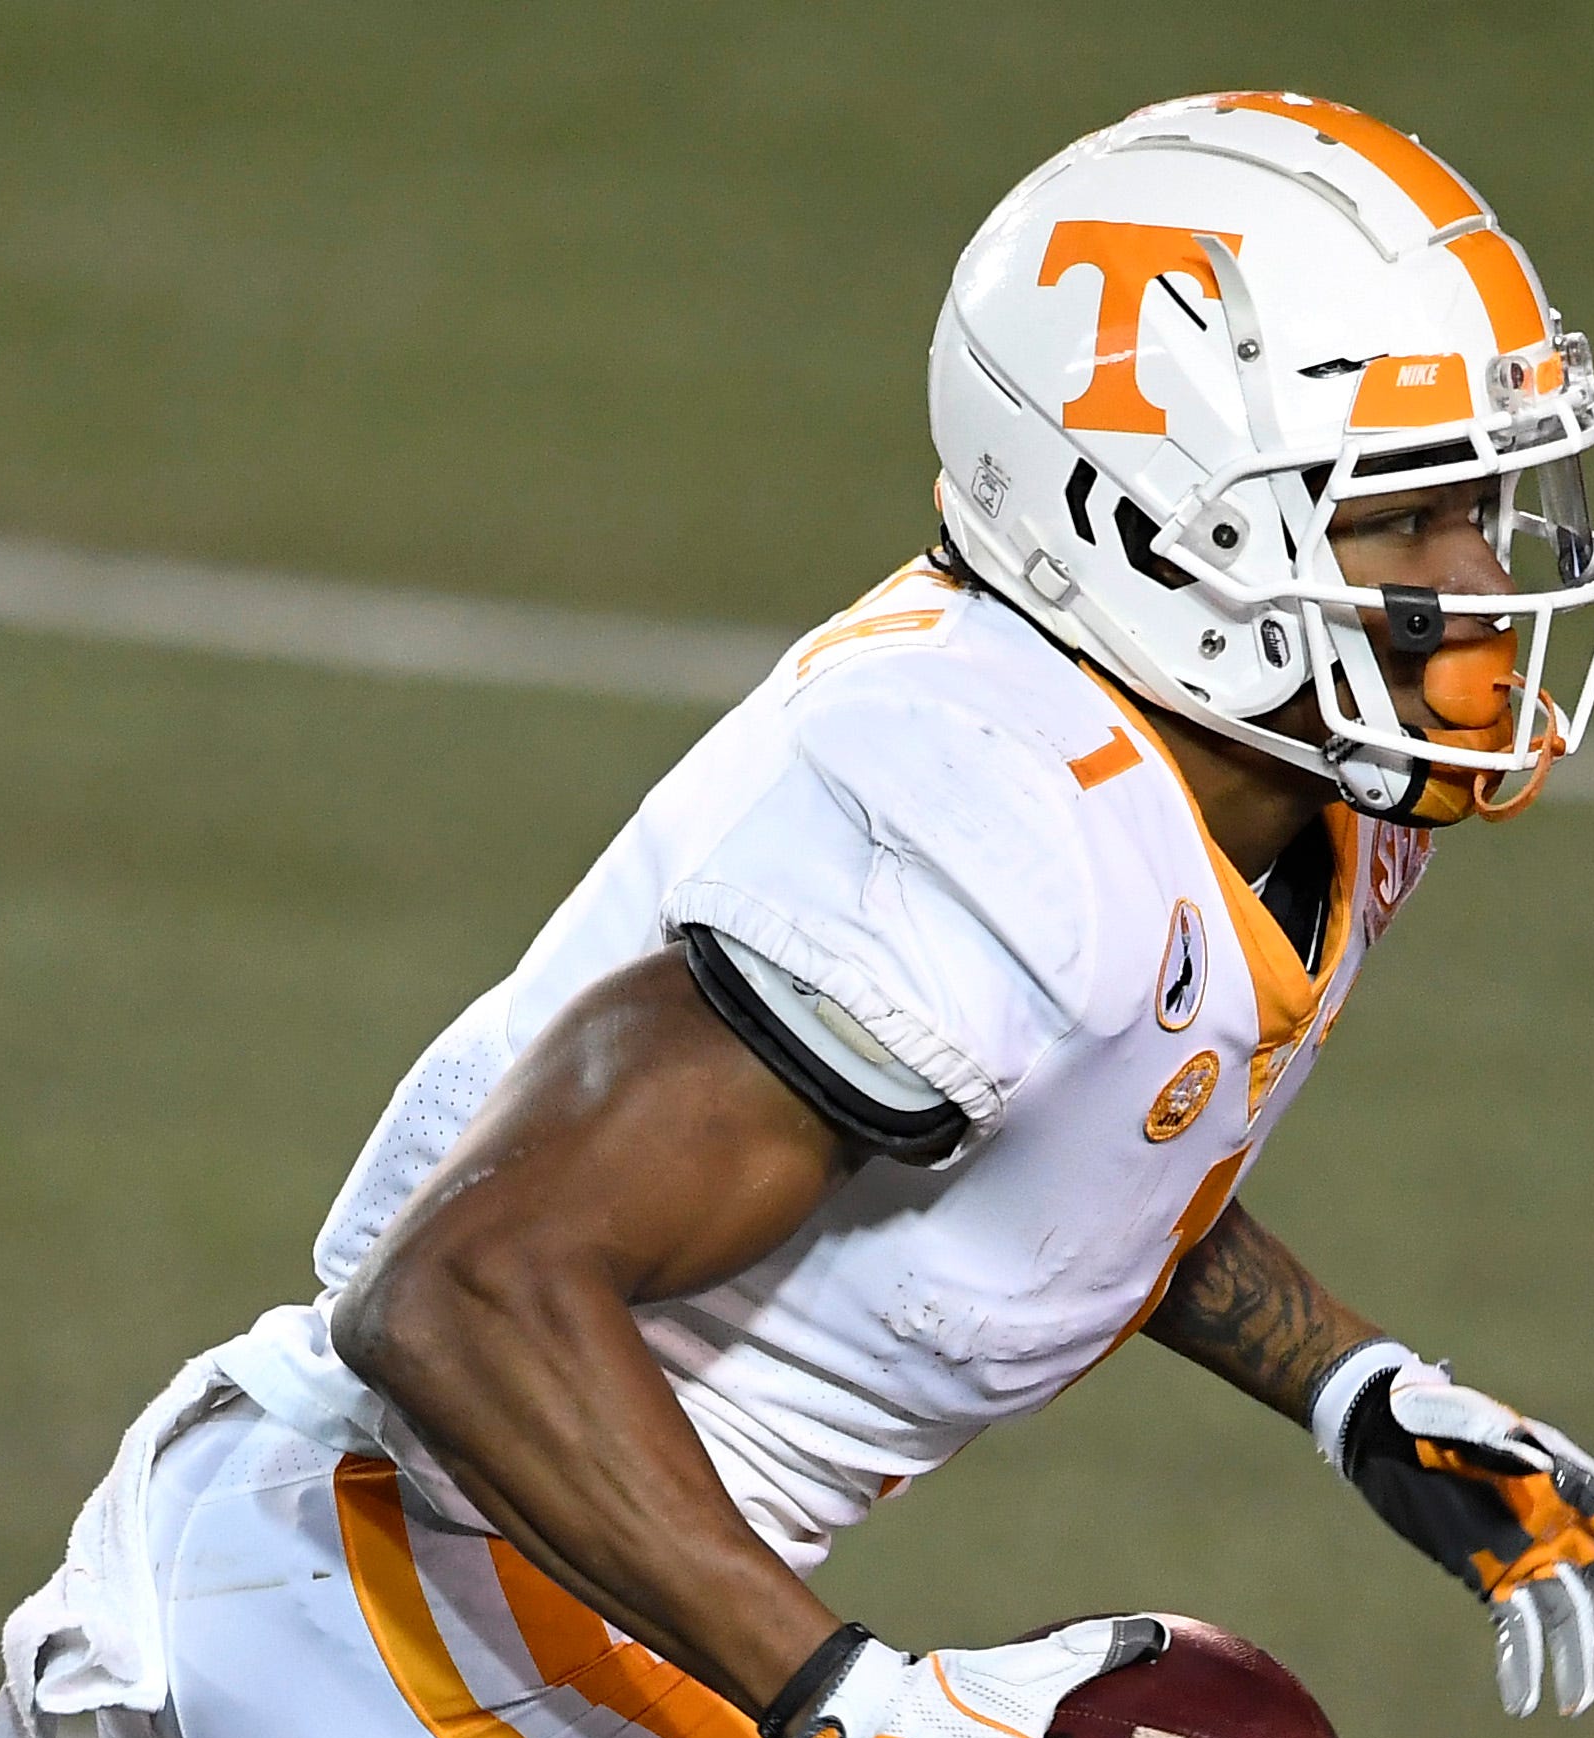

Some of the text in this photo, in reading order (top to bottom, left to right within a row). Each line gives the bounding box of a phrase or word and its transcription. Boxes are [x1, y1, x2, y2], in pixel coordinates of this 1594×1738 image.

[1037, 220, 1243, 435] T
[1396, 363, 1440, 387] NIKE
[1066, 726, 1144, 792] 1
